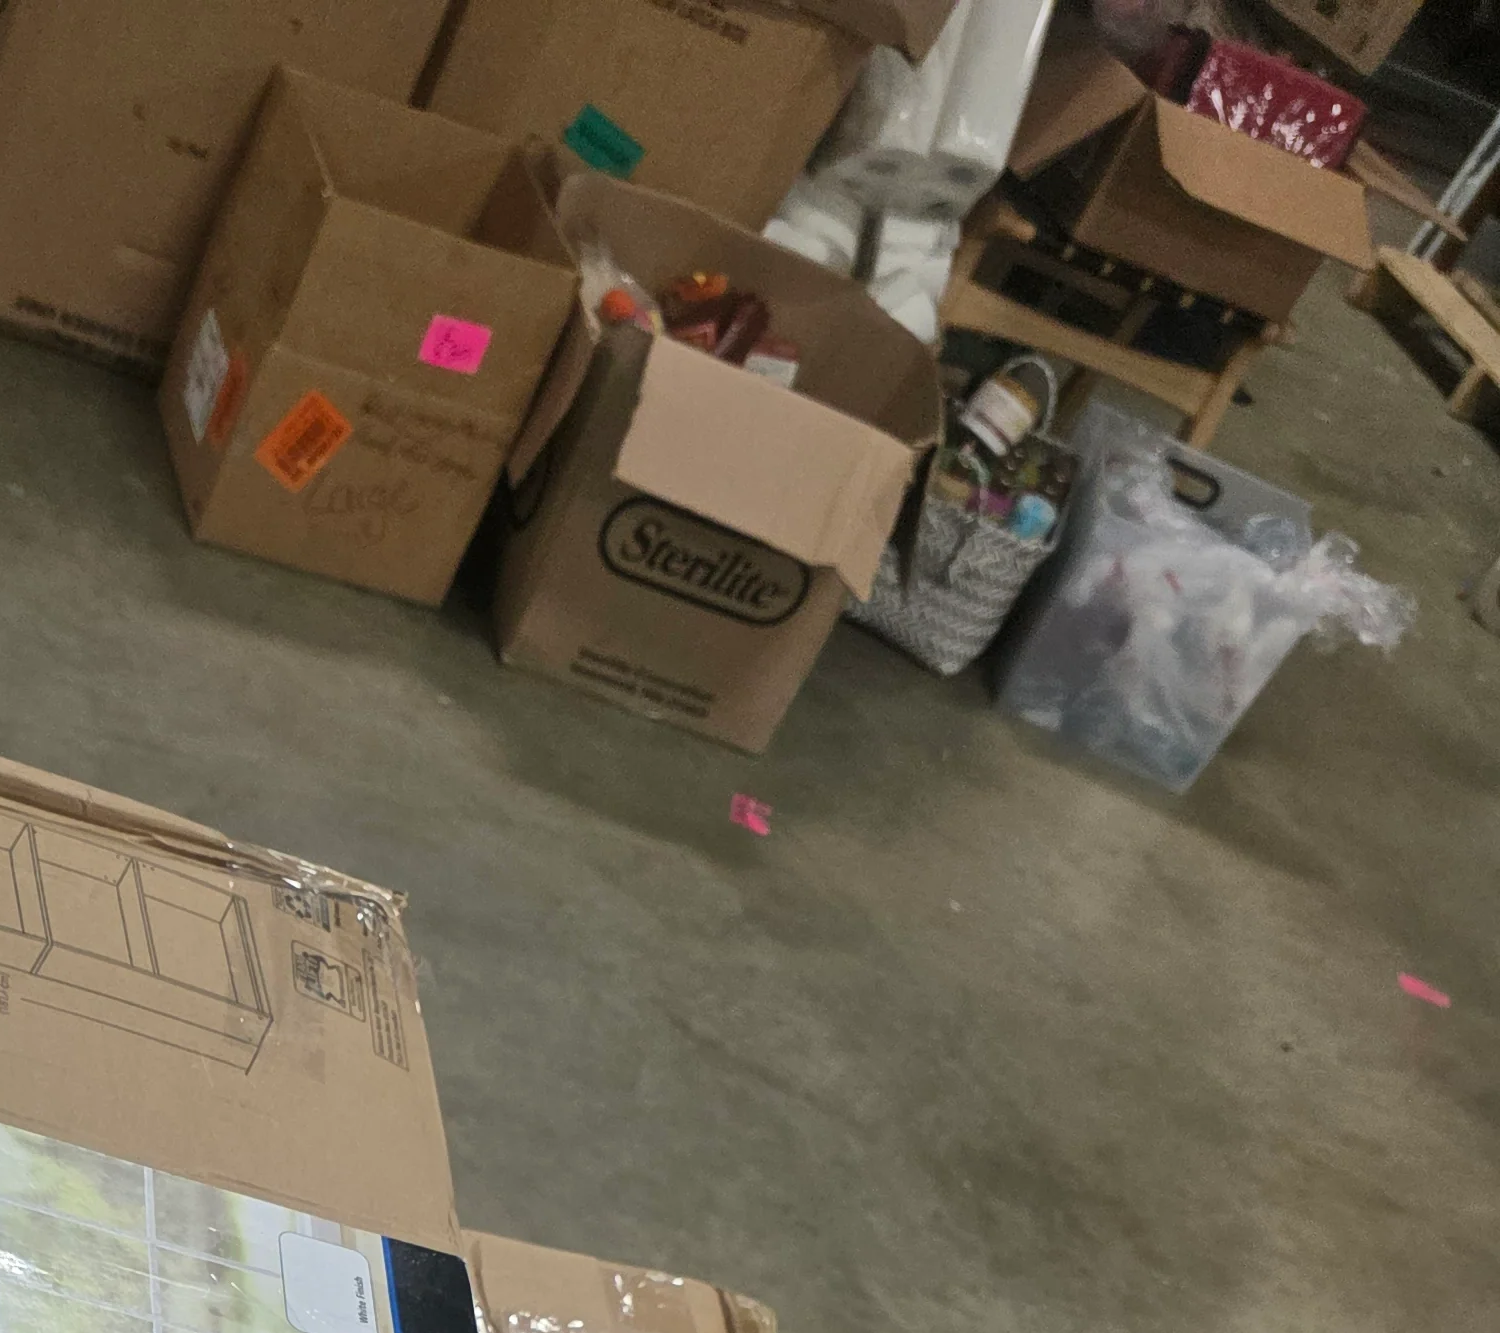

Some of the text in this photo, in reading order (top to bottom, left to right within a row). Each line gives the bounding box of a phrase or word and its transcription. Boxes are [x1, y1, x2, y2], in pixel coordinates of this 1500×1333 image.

[618, 516, 789, 609] Sterilite
[354, 1276, 369, 1324] White Finish
